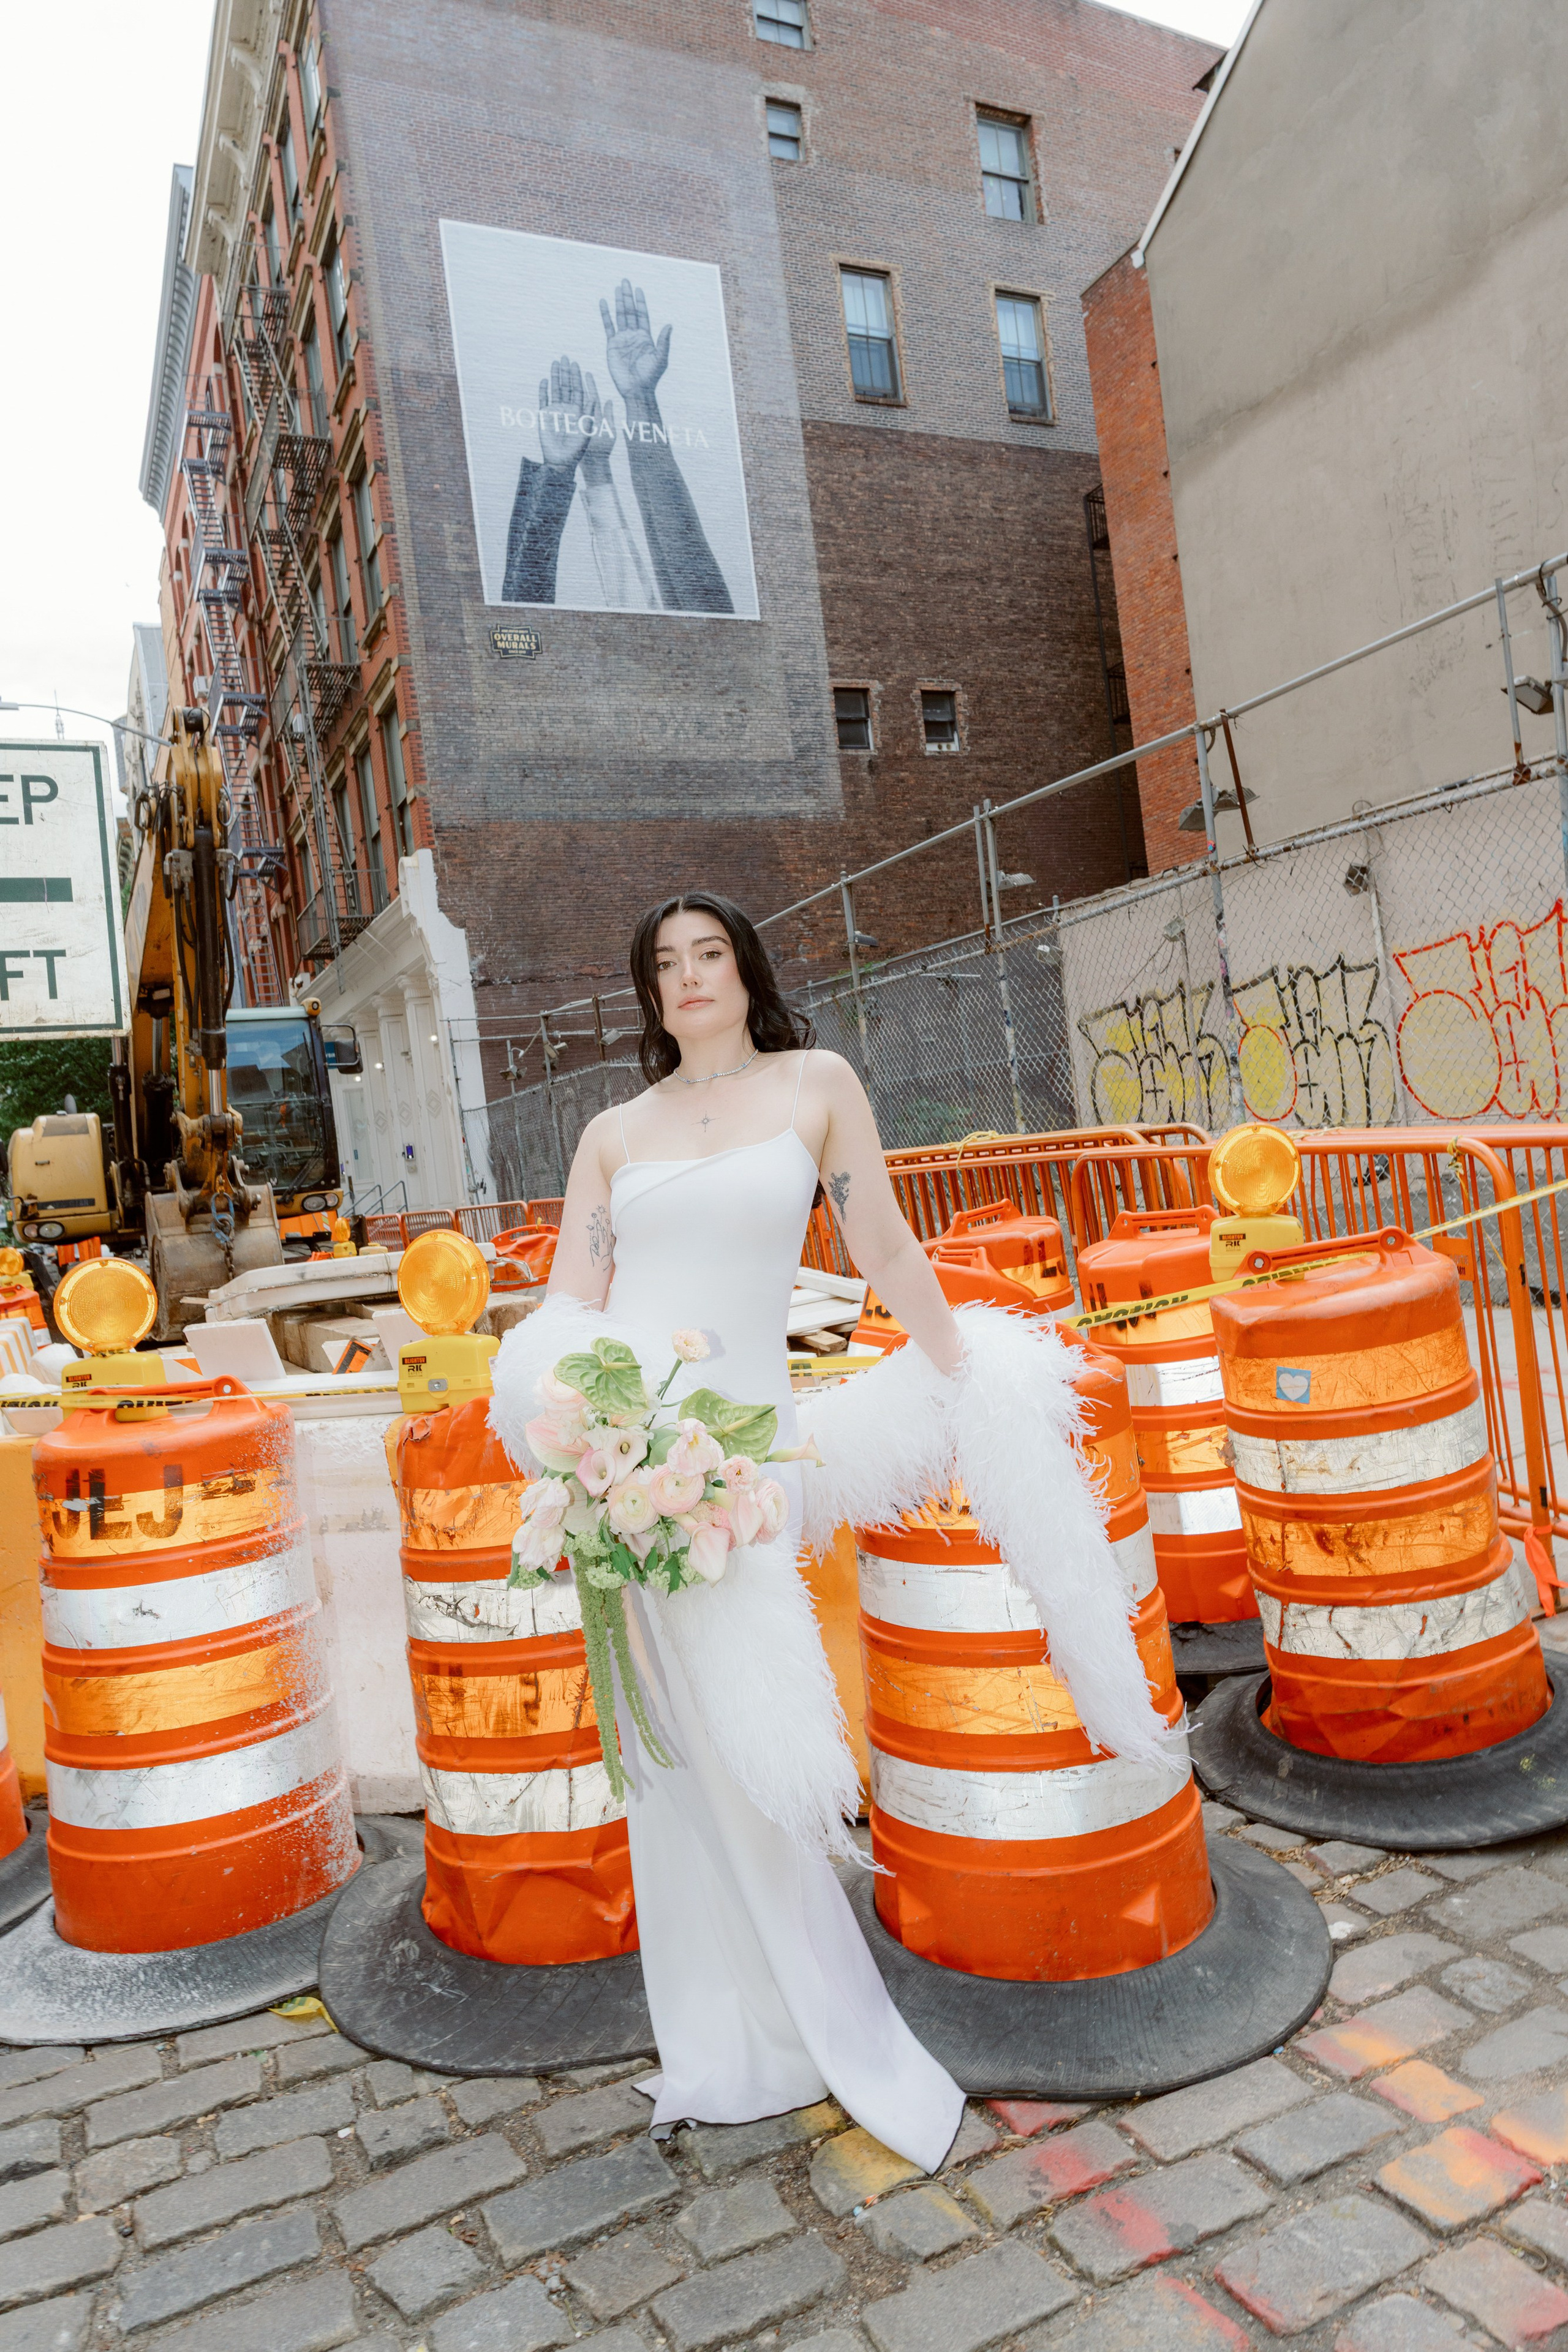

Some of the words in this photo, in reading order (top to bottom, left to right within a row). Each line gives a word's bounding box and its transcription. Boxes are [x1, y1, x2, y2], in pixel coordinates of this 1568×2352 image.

[500, 405, 615, 439] BOTTEGA
[620, 420, 709, 448] VENETA
[494, 633, 537, 643] OVERALL
[497, 641, 536, 650] MURALS
